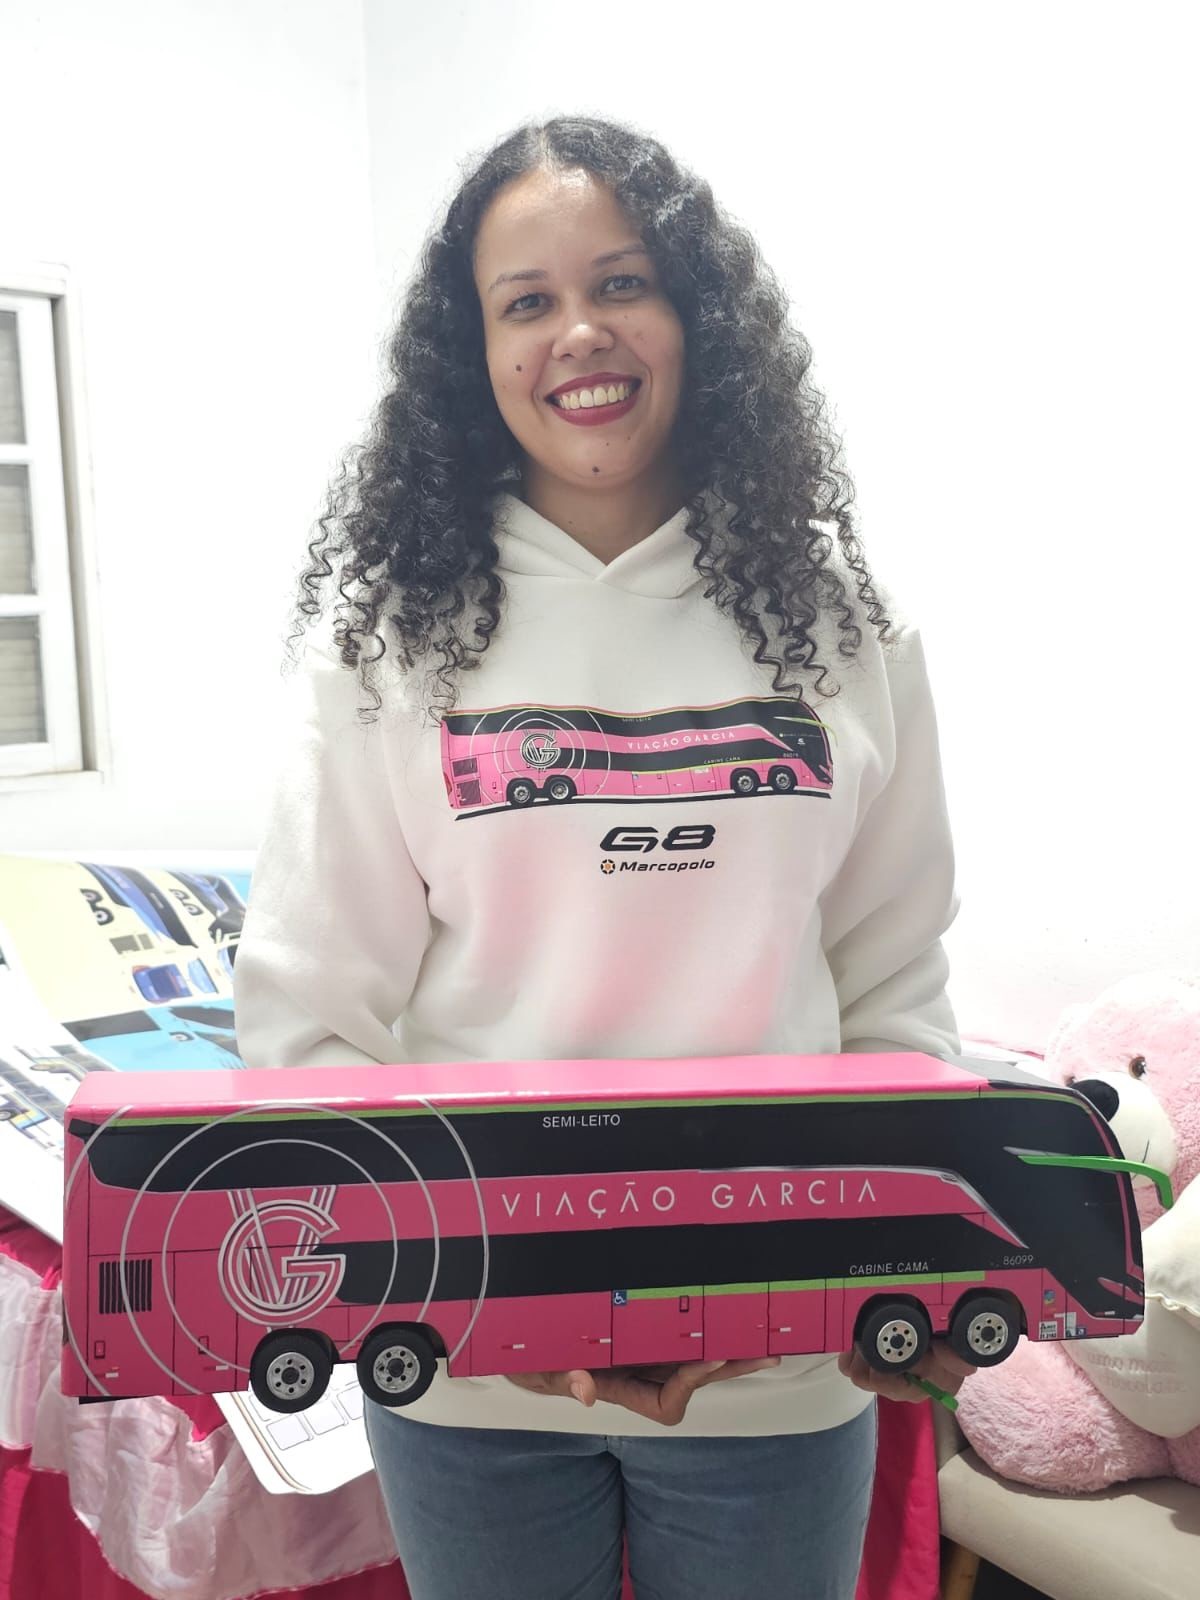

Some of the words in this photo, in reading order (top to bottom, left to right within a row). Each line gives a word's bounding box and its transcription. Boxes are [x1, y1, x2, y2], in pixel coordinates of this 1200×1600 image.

[627, 737, 679, 750] VIAÇÃO
[683, 731, 735, 744] GARCIA
[600, 824, 716, 853] G8
[619, 859, 715, 872] Marcopolo
[542, 1113, 621, 1128] SEMI-LEITO
[502, 1181, 675, 1219] VIAÇÃO
[711, 1179, 876, 1208] GARCIA
[1003, 1254, 1034, 1266] 86099
[849, 1263, 893, 1276] CABINE
[896, 1261, 929, 1273] CAMA
